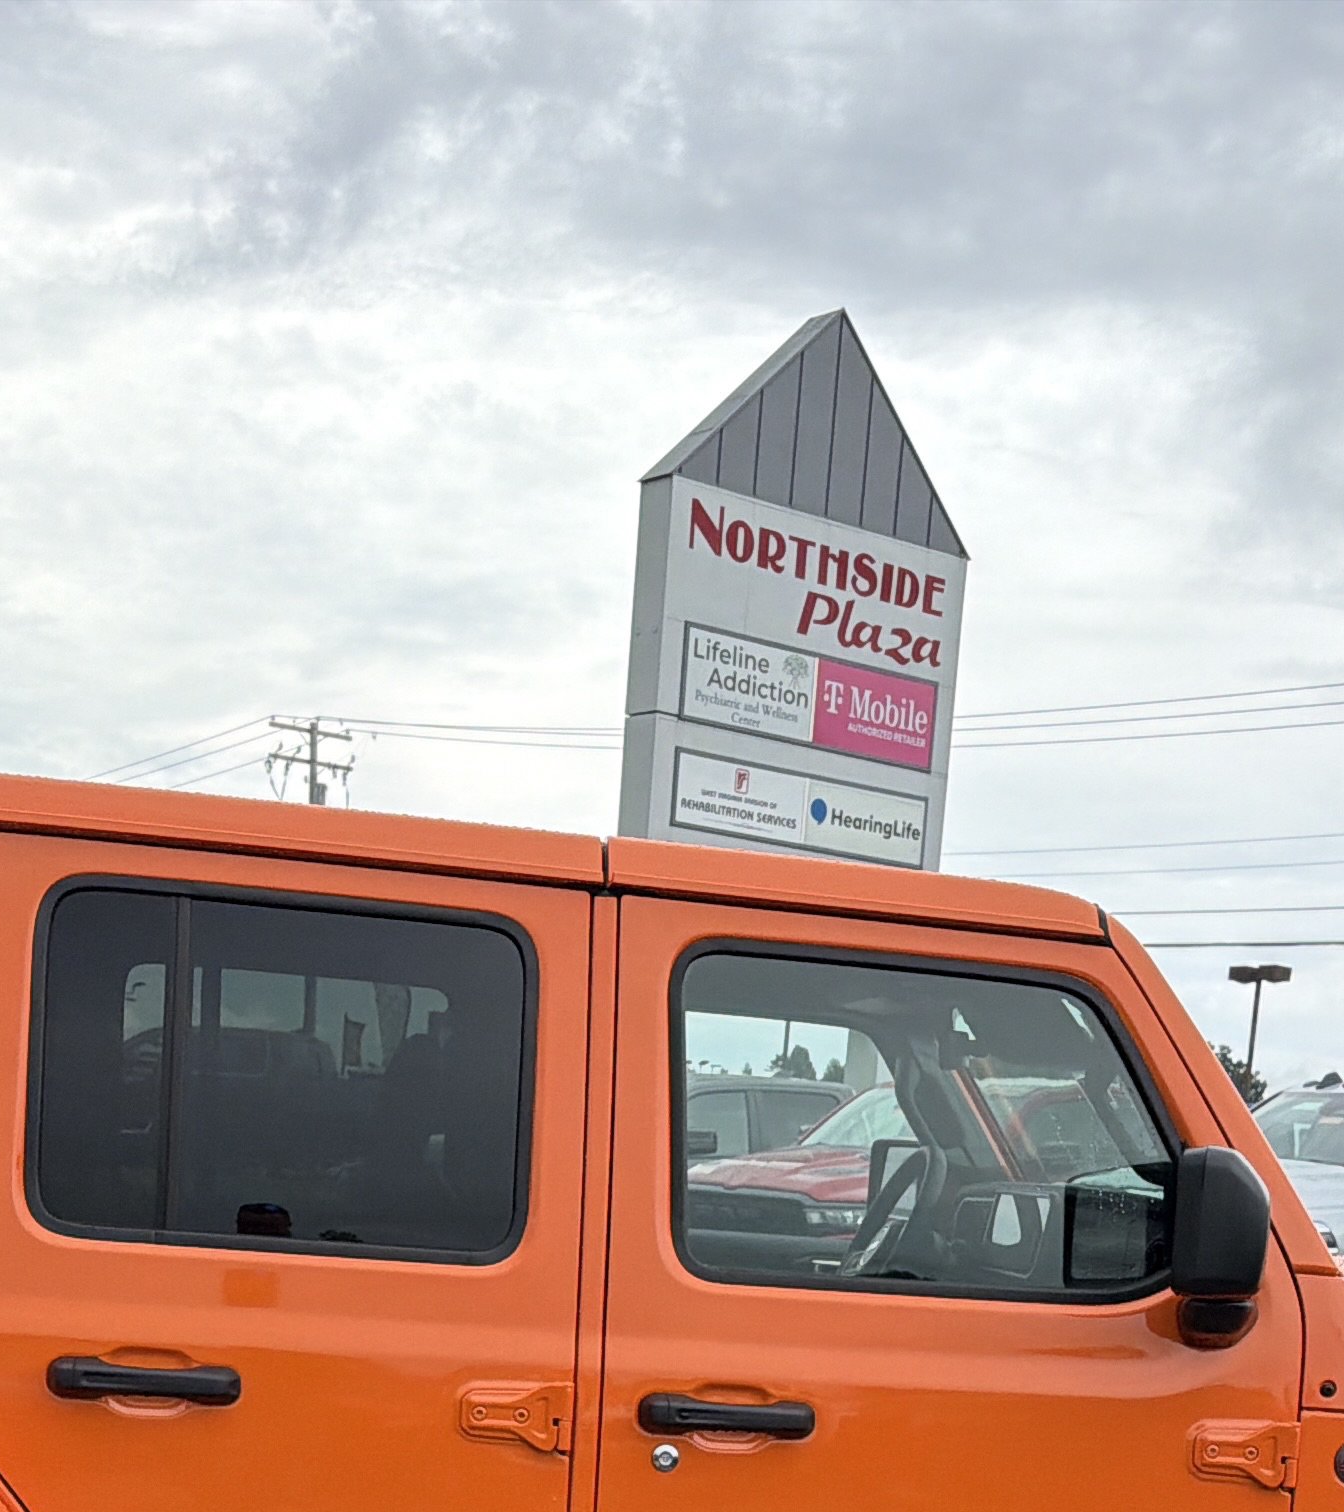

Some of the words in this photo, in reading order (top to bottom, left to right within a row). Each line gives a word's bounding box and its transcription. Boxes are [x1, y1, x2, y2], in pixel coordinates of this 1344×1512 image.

[688, 497, 946, 617] NORTHSIDE
[797, 591, 941, 667] Plaza
[693, 637, 770, 674] Lifeline
[694, 688, 742, 710] Psychiatric
[743, 701, 760, 714] and
[761, 703, 799, 723] Wellness
[706, 667, 809, 709] Addiction
[730, 711, 761, 728] Center
[848, 685, 928, 734] Mobile
[680, 797, 755, 821] REHABILITATION
[756, 812, 797, 829] SERVICES
[830, 807, 921, 840] HearingLife
